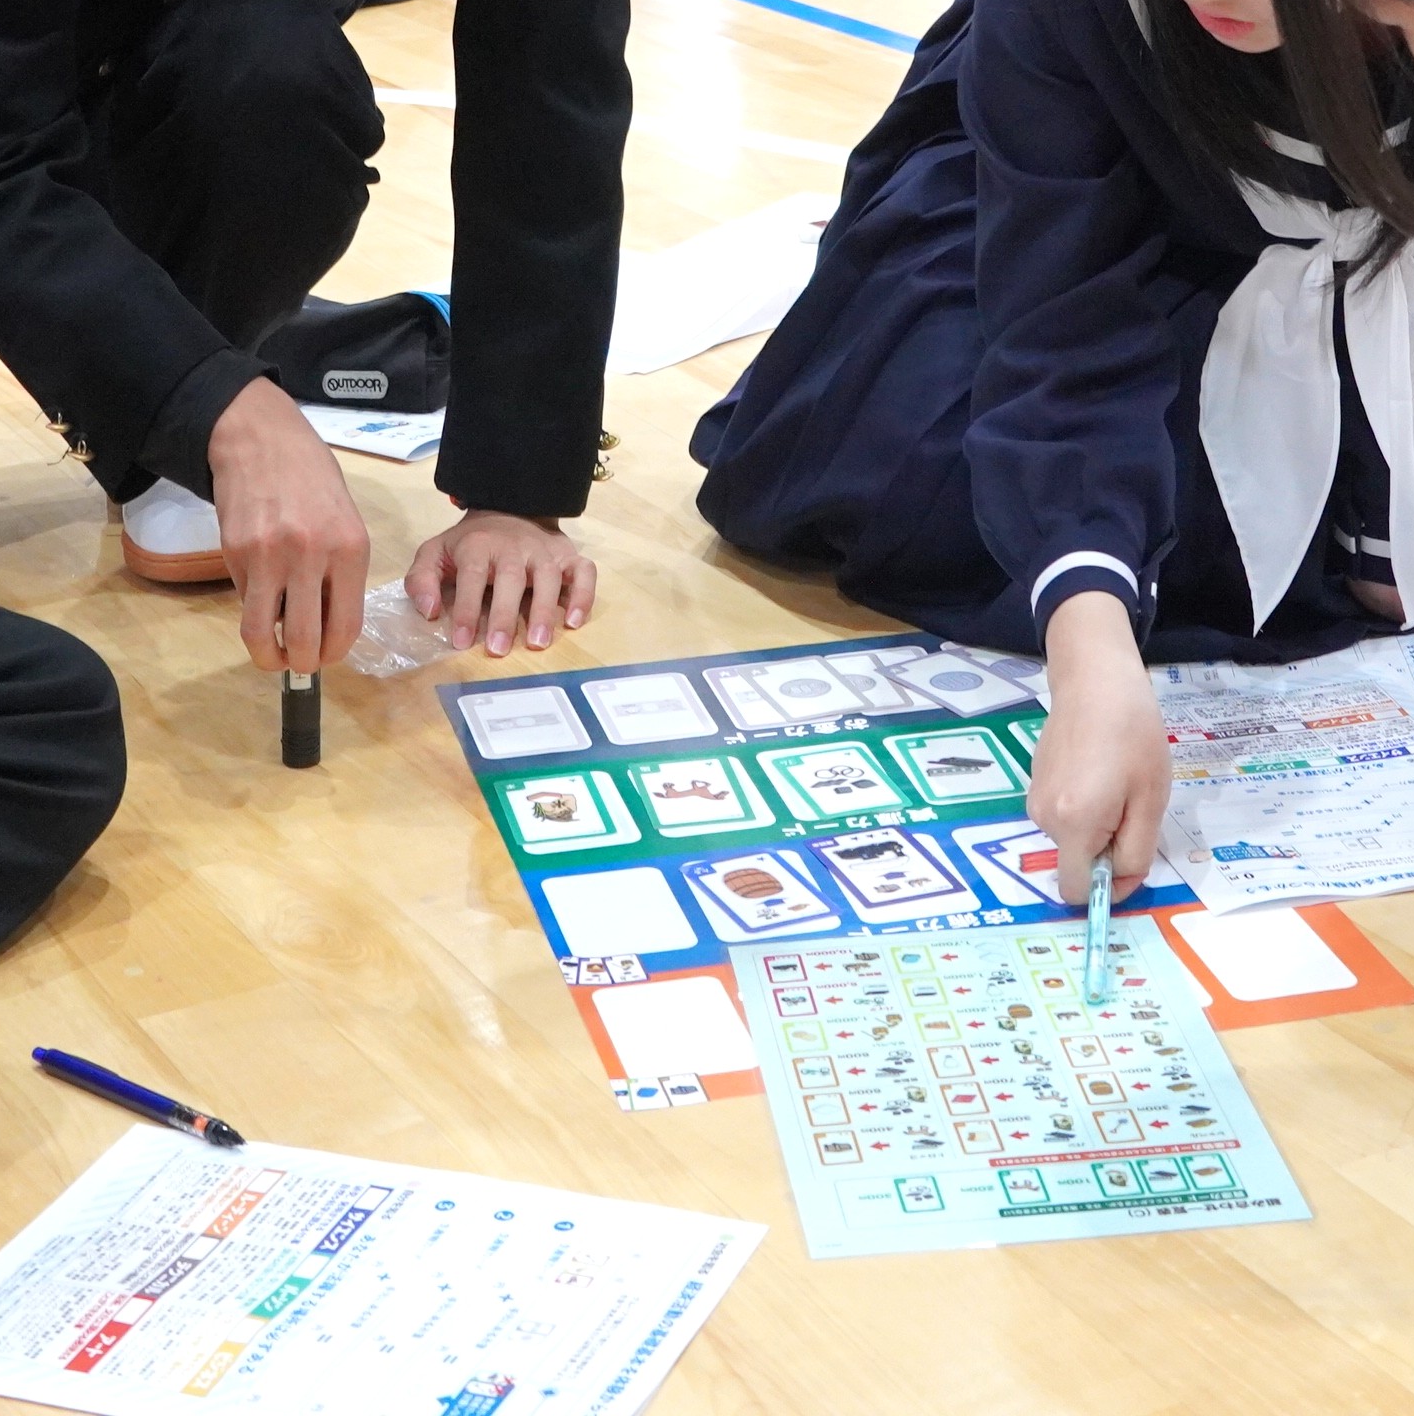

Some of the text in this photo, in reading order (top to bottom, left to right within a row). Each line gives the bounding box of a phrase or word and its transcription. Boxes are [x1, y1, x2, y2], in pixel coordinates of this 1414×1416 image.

[327, 378, 382, 392] OUTDOOR
[723, 718, 869, 744] お金カード
[1212, 726, 1269, 738] テクニカル
[1308, 714, 1369, 727] ルーティーン
[1254, 761, 1295, 771] パーソン
[1342, 748, 1404, 763] サイエンス
[1180, 762, 1386, 787] あなたが活躍する場所は必ずある
[782, 810, 938, 837] 資源カード
[206, 1193, 261, 1235] ルーティーン
[1154, 1197, 1283, 1215] 組み合わせ一覧表
[315, 1210, 368, 1251] サイエンス
[140, 1259, 196, 1296] テクニカル
[234, 1234, 379, 1375] あなたが活躍する場所は必ずある
[253, 1282, 304, 1313] パーソン
[78, 1332, 122, 1359] アート
